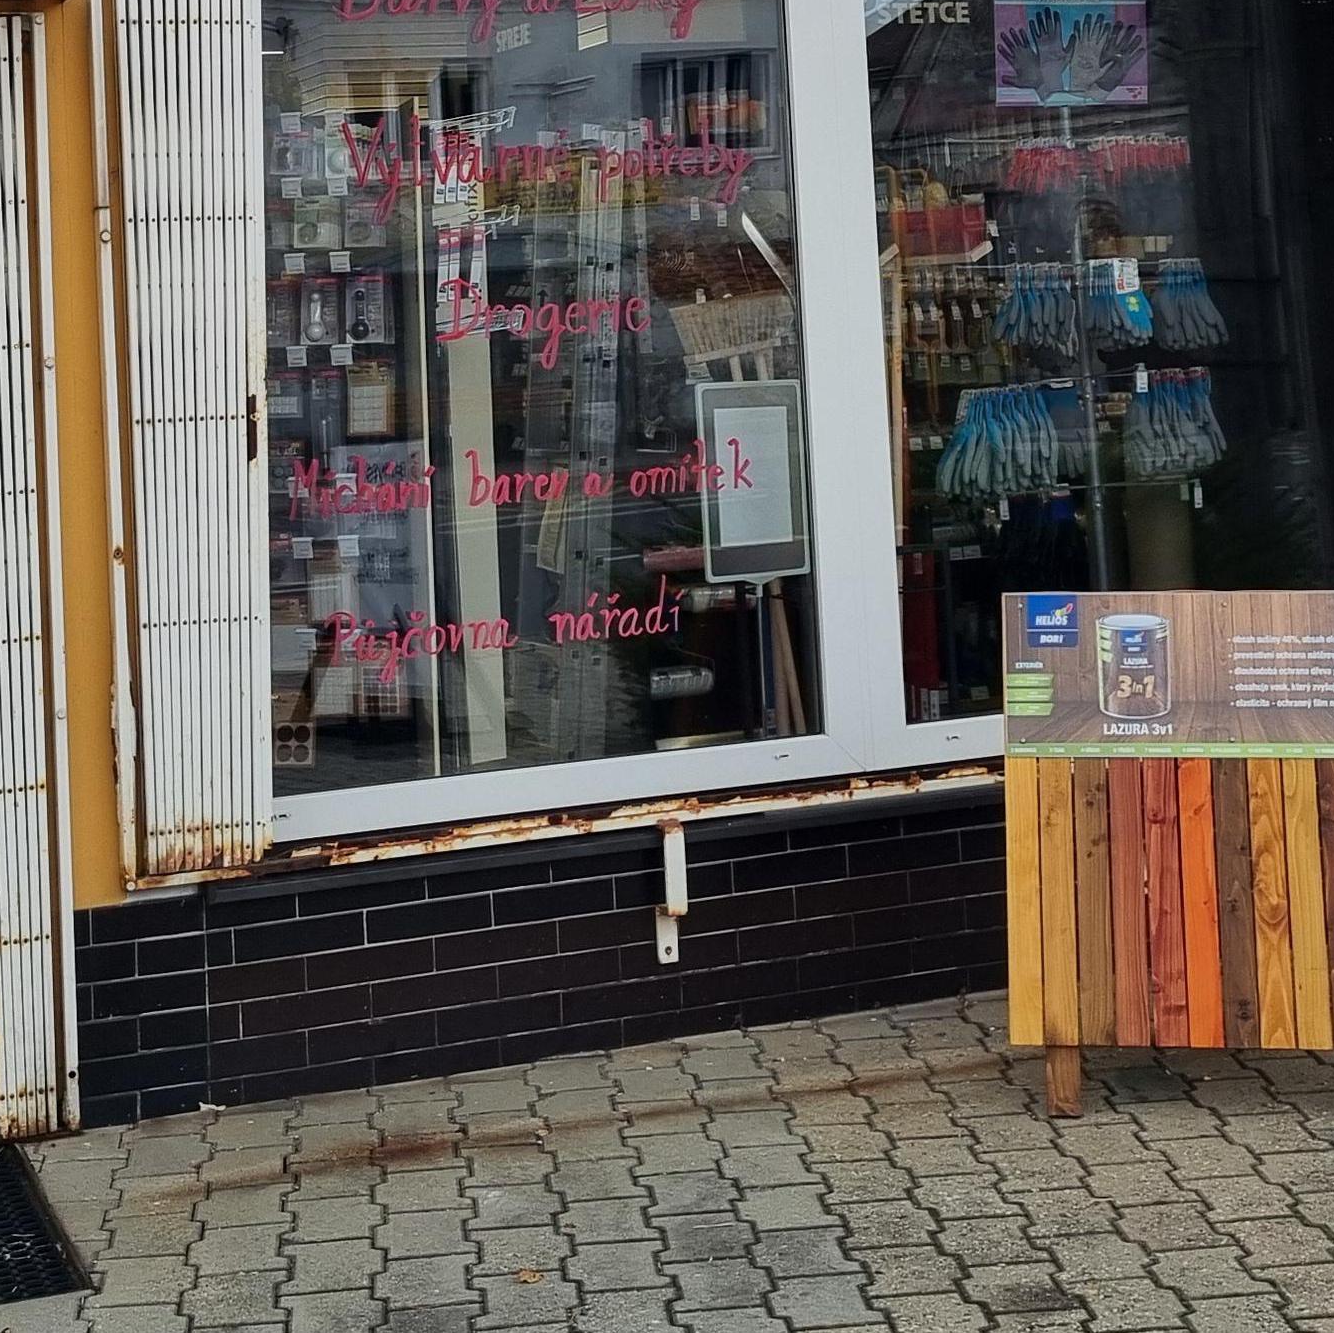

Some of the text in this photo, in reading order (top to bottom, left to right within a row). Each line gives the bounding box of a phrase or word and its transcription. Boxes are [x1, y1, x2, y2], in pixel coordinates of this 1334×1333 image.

[496, 22, 531, 54] SPREJE
[596, 115, 754, 205] potřeby
[436, 279, 652, 369] Drogerie
[465, 450, 569, 508] barev
[583, 470, 614, 499] a
[629, 437, 754, 497] omítek
[323, 574, 686, 685] Půjčovna nářadí
[1035, 615, 1068, 626] HELIOS
[1039, 634, 1063, 644] BORI
[1103, 723, 1173, 735] LAZURA 3v1
